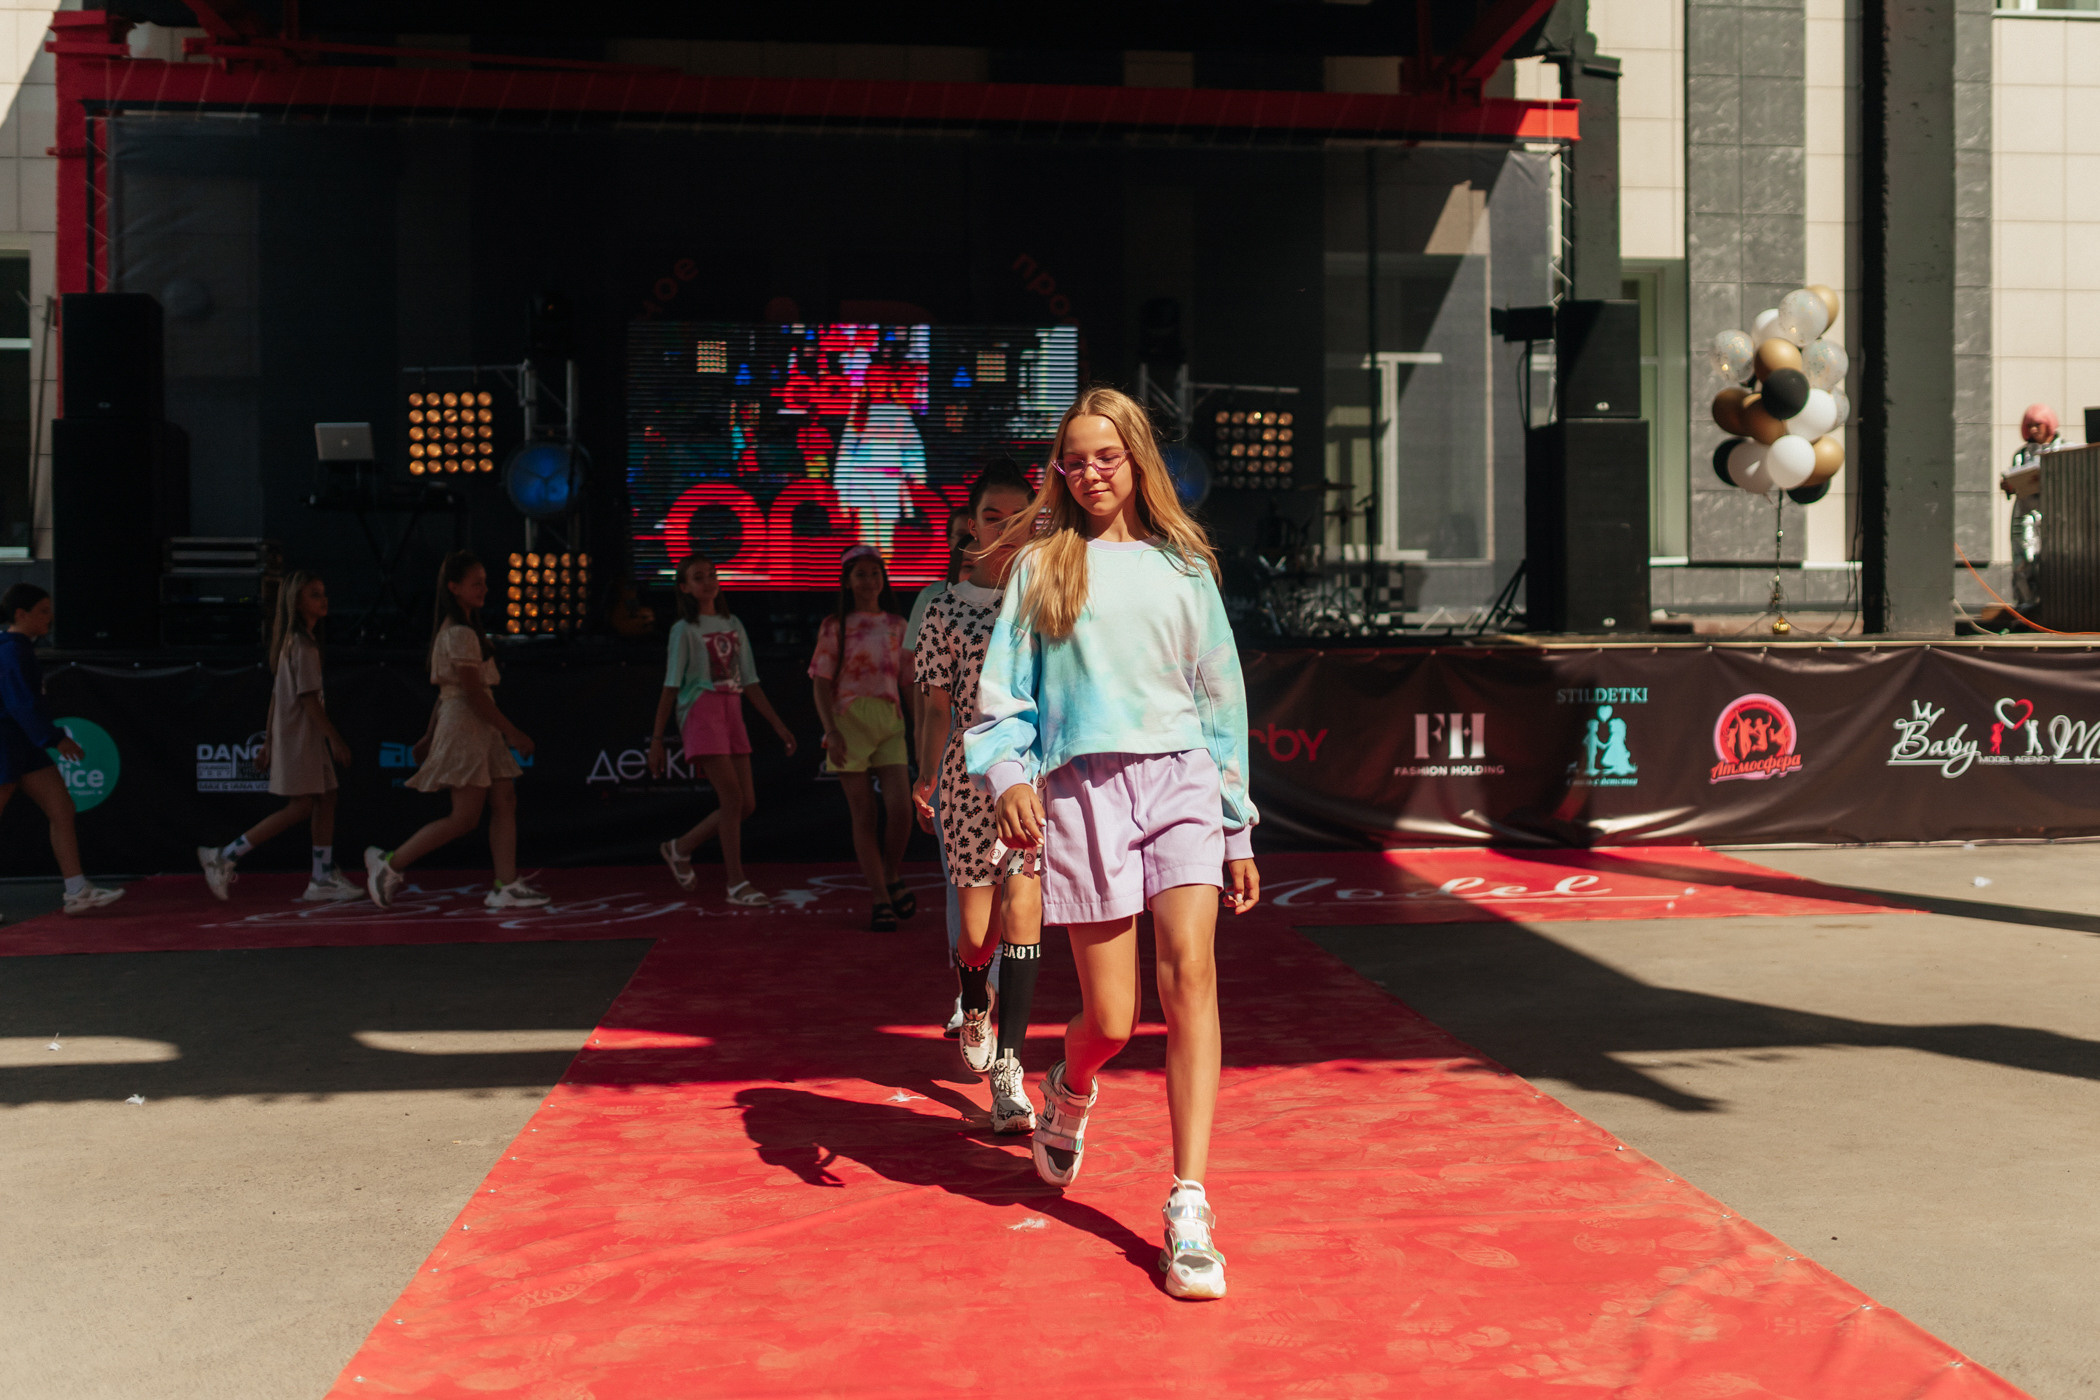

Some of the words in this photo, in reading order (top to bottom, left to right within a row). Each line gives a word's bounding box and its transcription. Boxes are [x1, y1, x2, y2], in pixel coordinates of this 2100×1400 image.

[1556, 686, 1649, 704] STILDETKI
[1891, 719, 1980, 778] Baby
[1394, 766, 1448, 777] FASHION
[1450, 765, 1505, 776] HOLDING
[1709, 754, 1802, 779] Атмосфера
